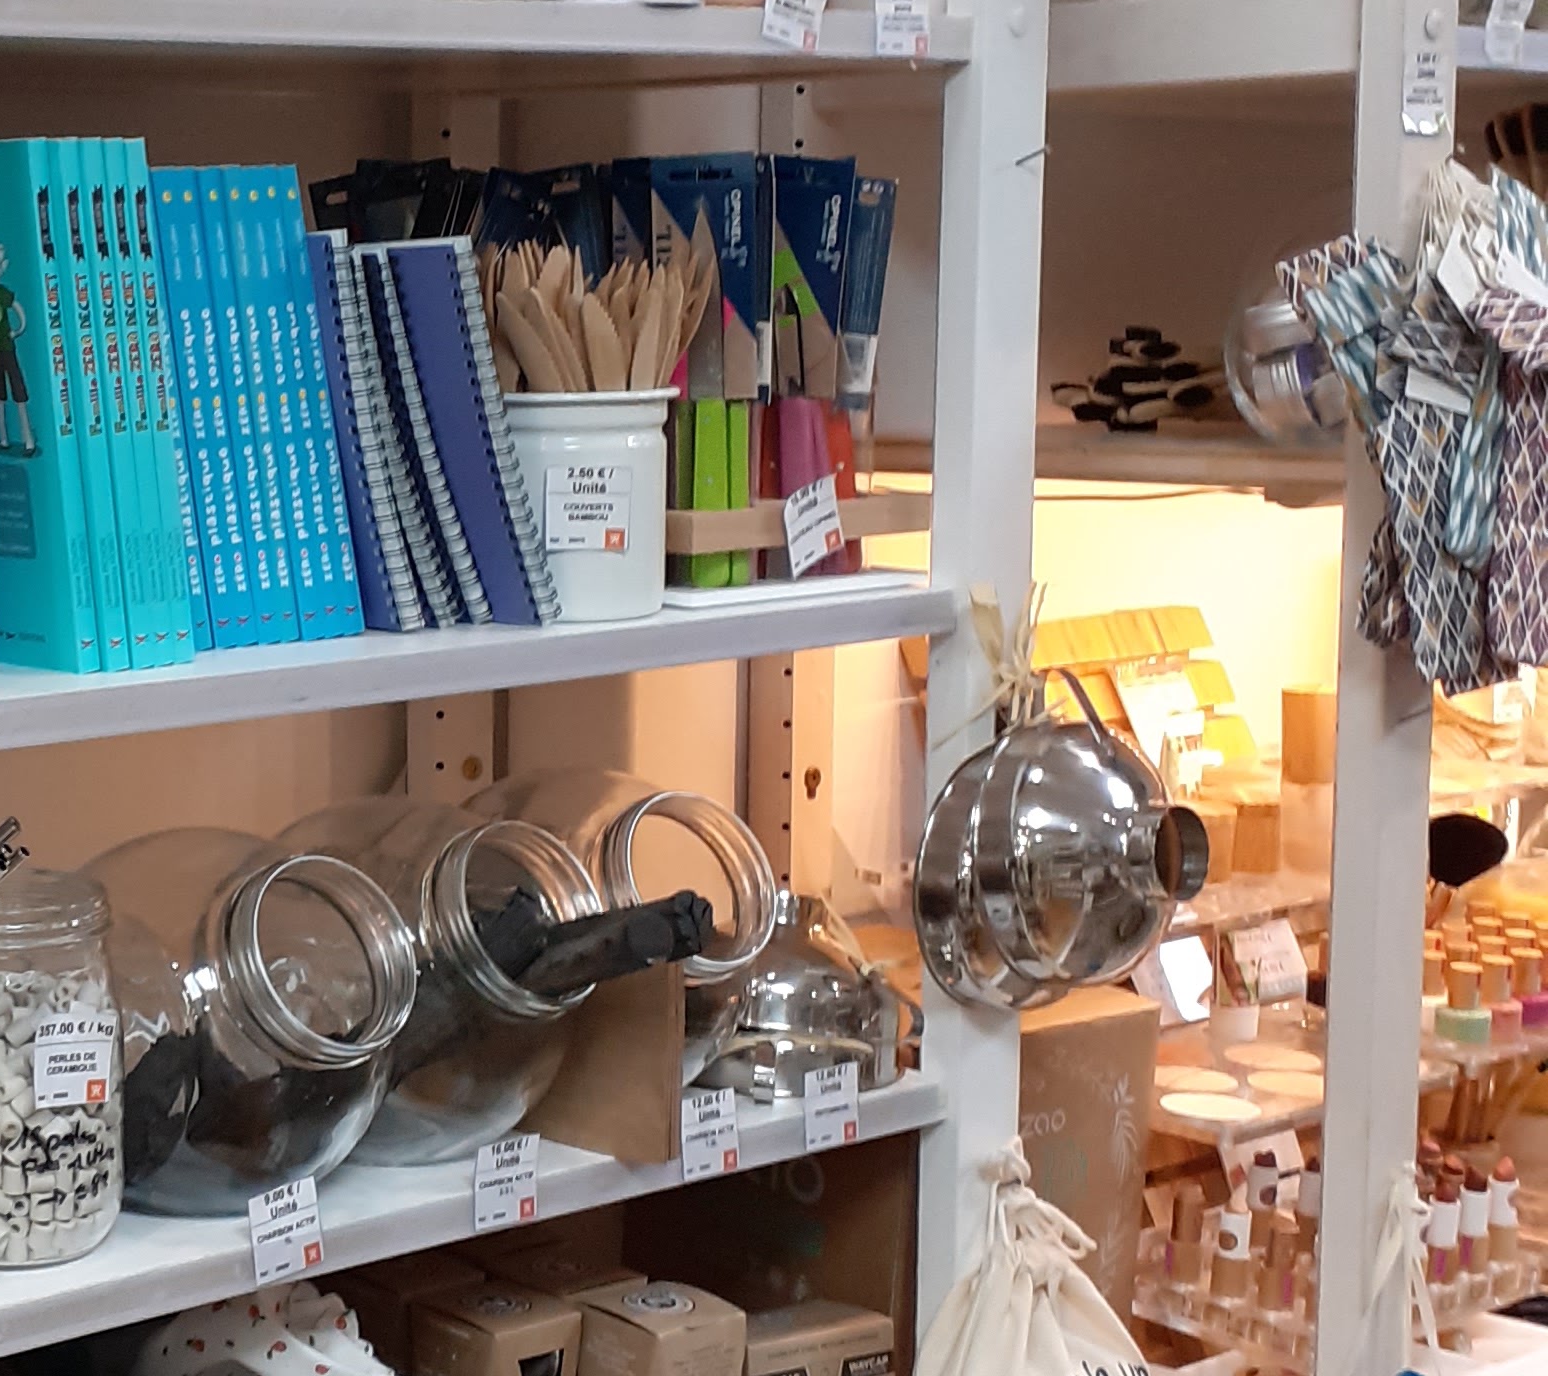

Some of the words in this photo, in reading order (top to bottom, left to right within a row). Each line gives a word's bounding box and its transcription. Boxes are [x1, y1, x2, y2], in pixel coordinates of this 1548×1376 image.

[180, 309, 199, 390] toxique
[201, 308, 219, 388] toxique
[226, 306, 244, 386] toxique
[267, 306, 286, 384] toxique
[198, 448, 222, 546] plastique
[218, 447, 243, 544] plastique
[243, 444, 267, 542] plastique
[285, 443, 309, 540] plastique
[572, 481, 607, 494] Unité
[48, 1052, 82, 1064] PERLES
[84, 1052, 97, 1061] DE
[97, 1022, 114, 1036] kg
[270, 1199, 298, 1220] Unité
